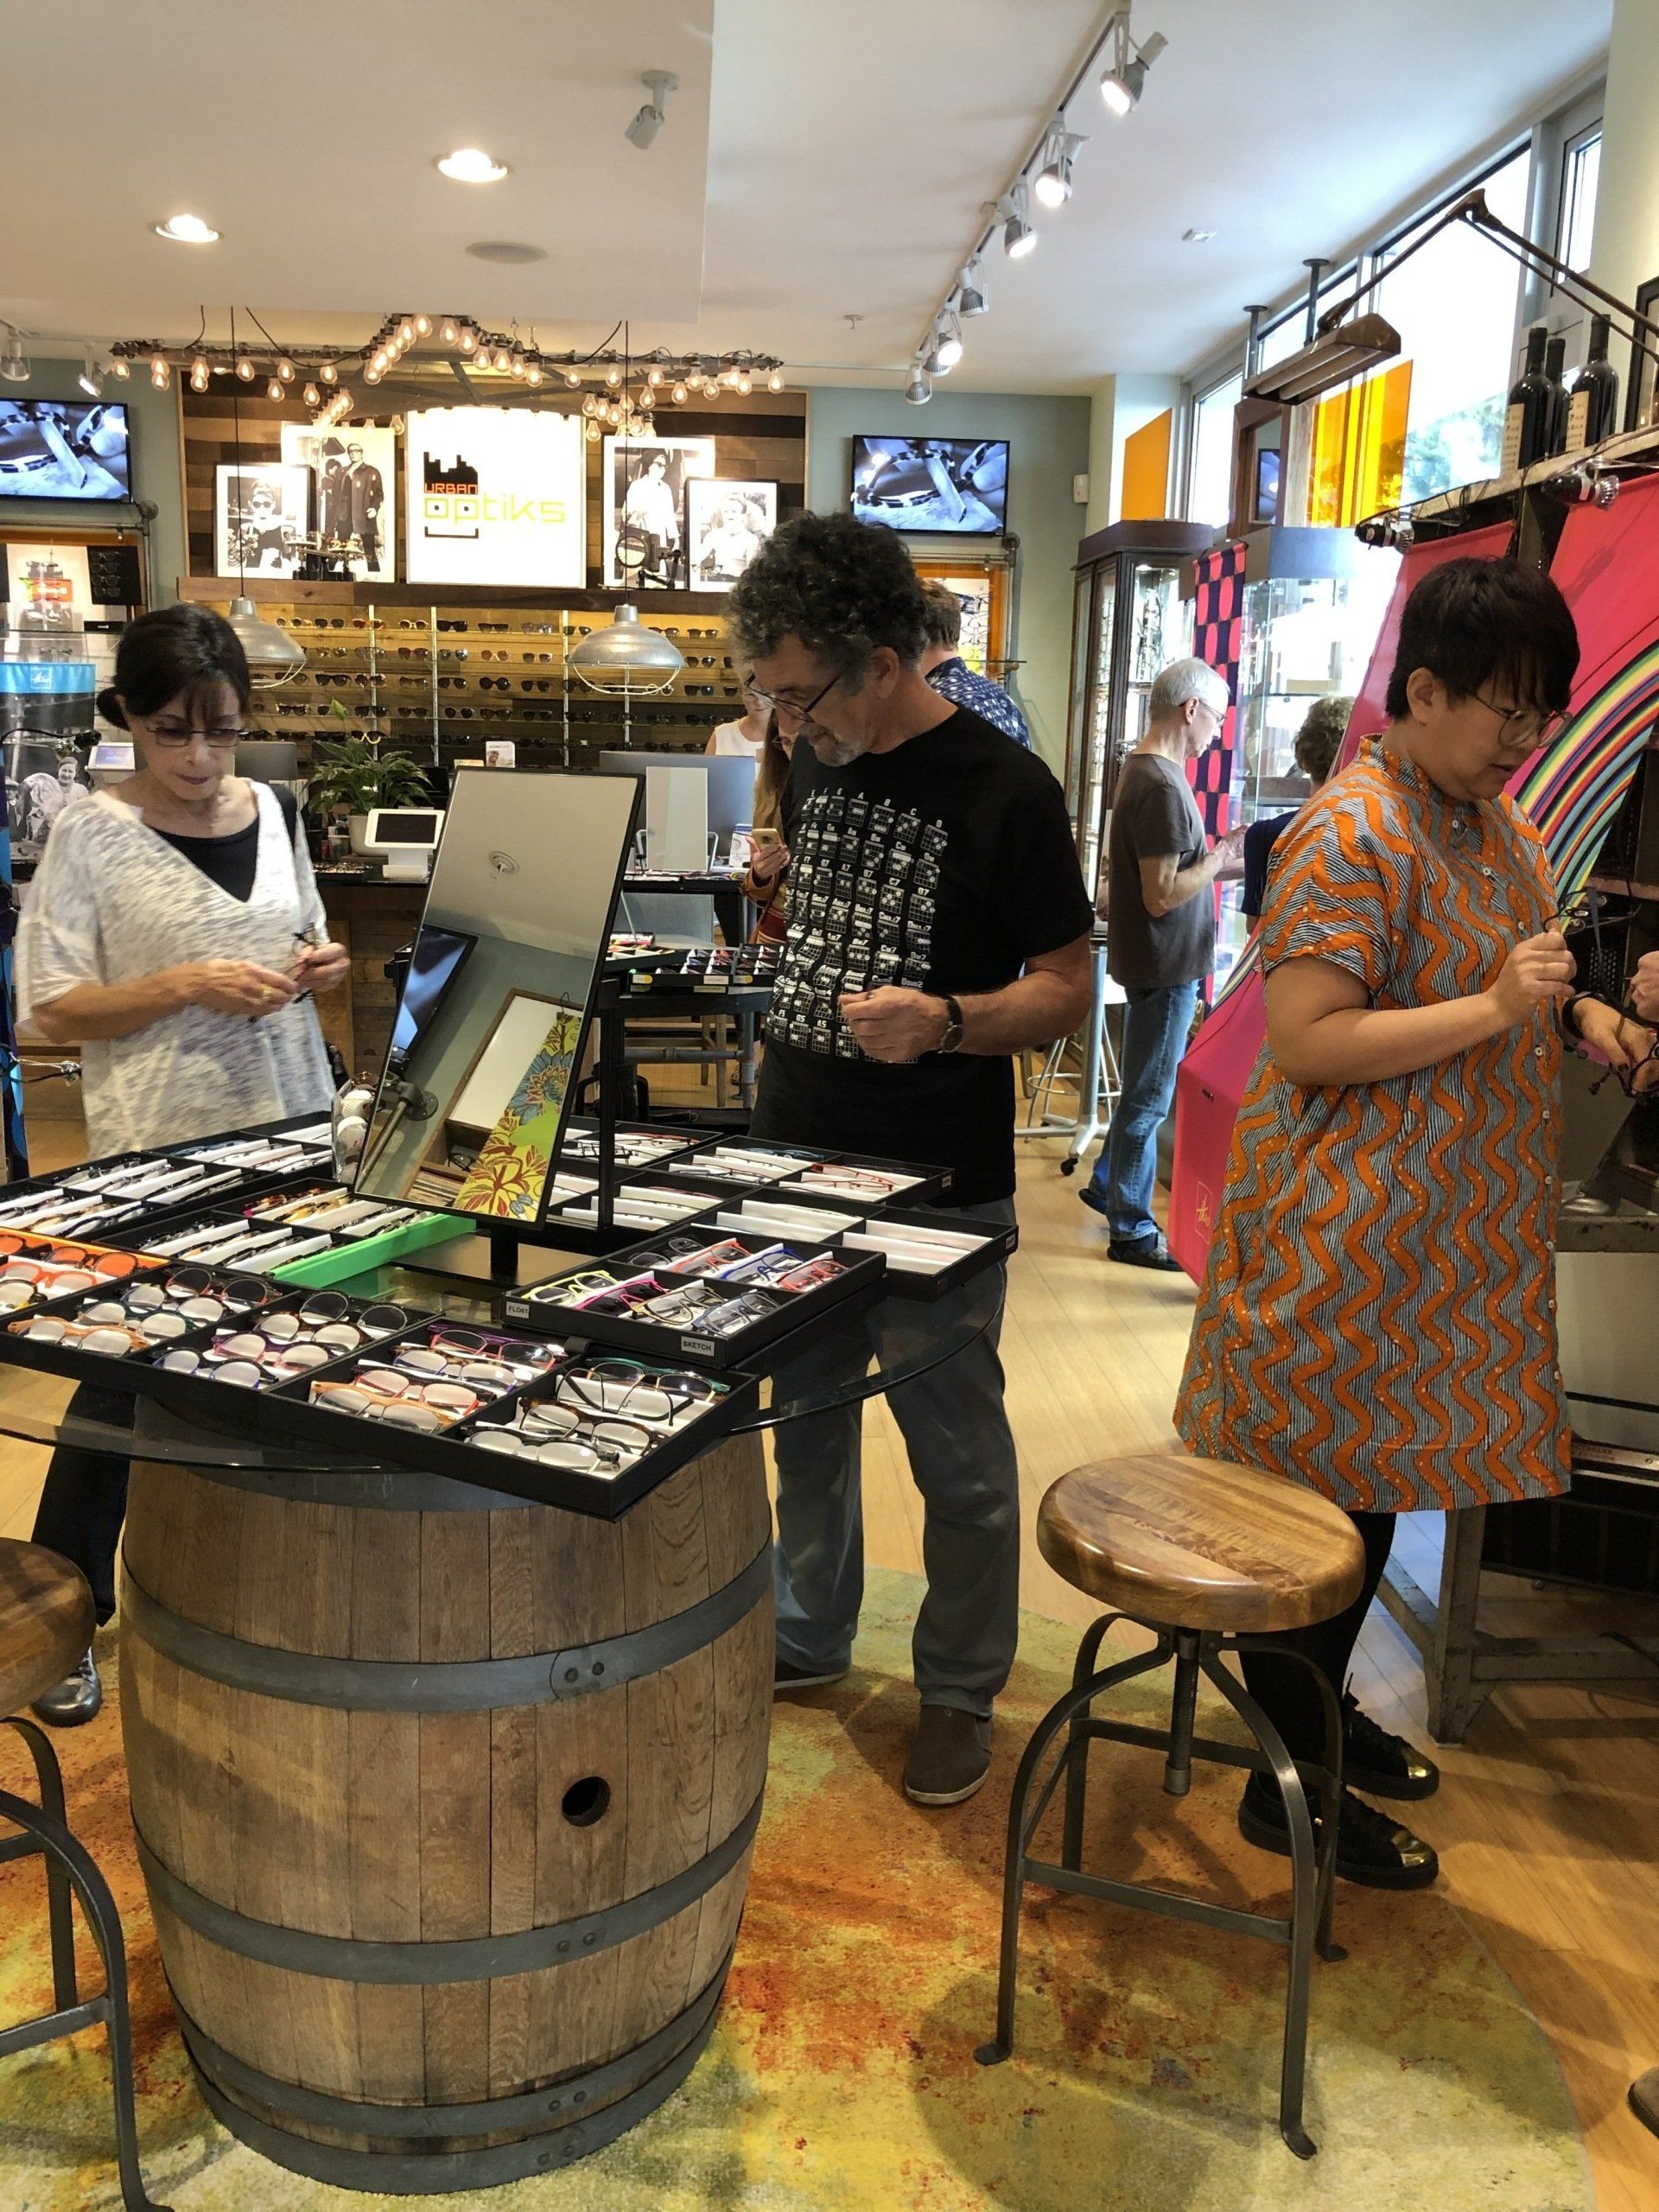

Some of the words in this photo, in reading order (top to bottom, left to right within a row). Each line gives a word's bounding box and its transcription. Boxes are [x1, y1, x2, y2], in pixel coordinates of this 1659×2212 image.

[424, 493, 566, 525] optiks
[936, 819, 943, 828] D
[863, 869, 874, 878] B7
[888, 877, 901, 887] C7
[918, 887, 930, 896] D7
[683, 1340, 712, 1351] SKETCH
